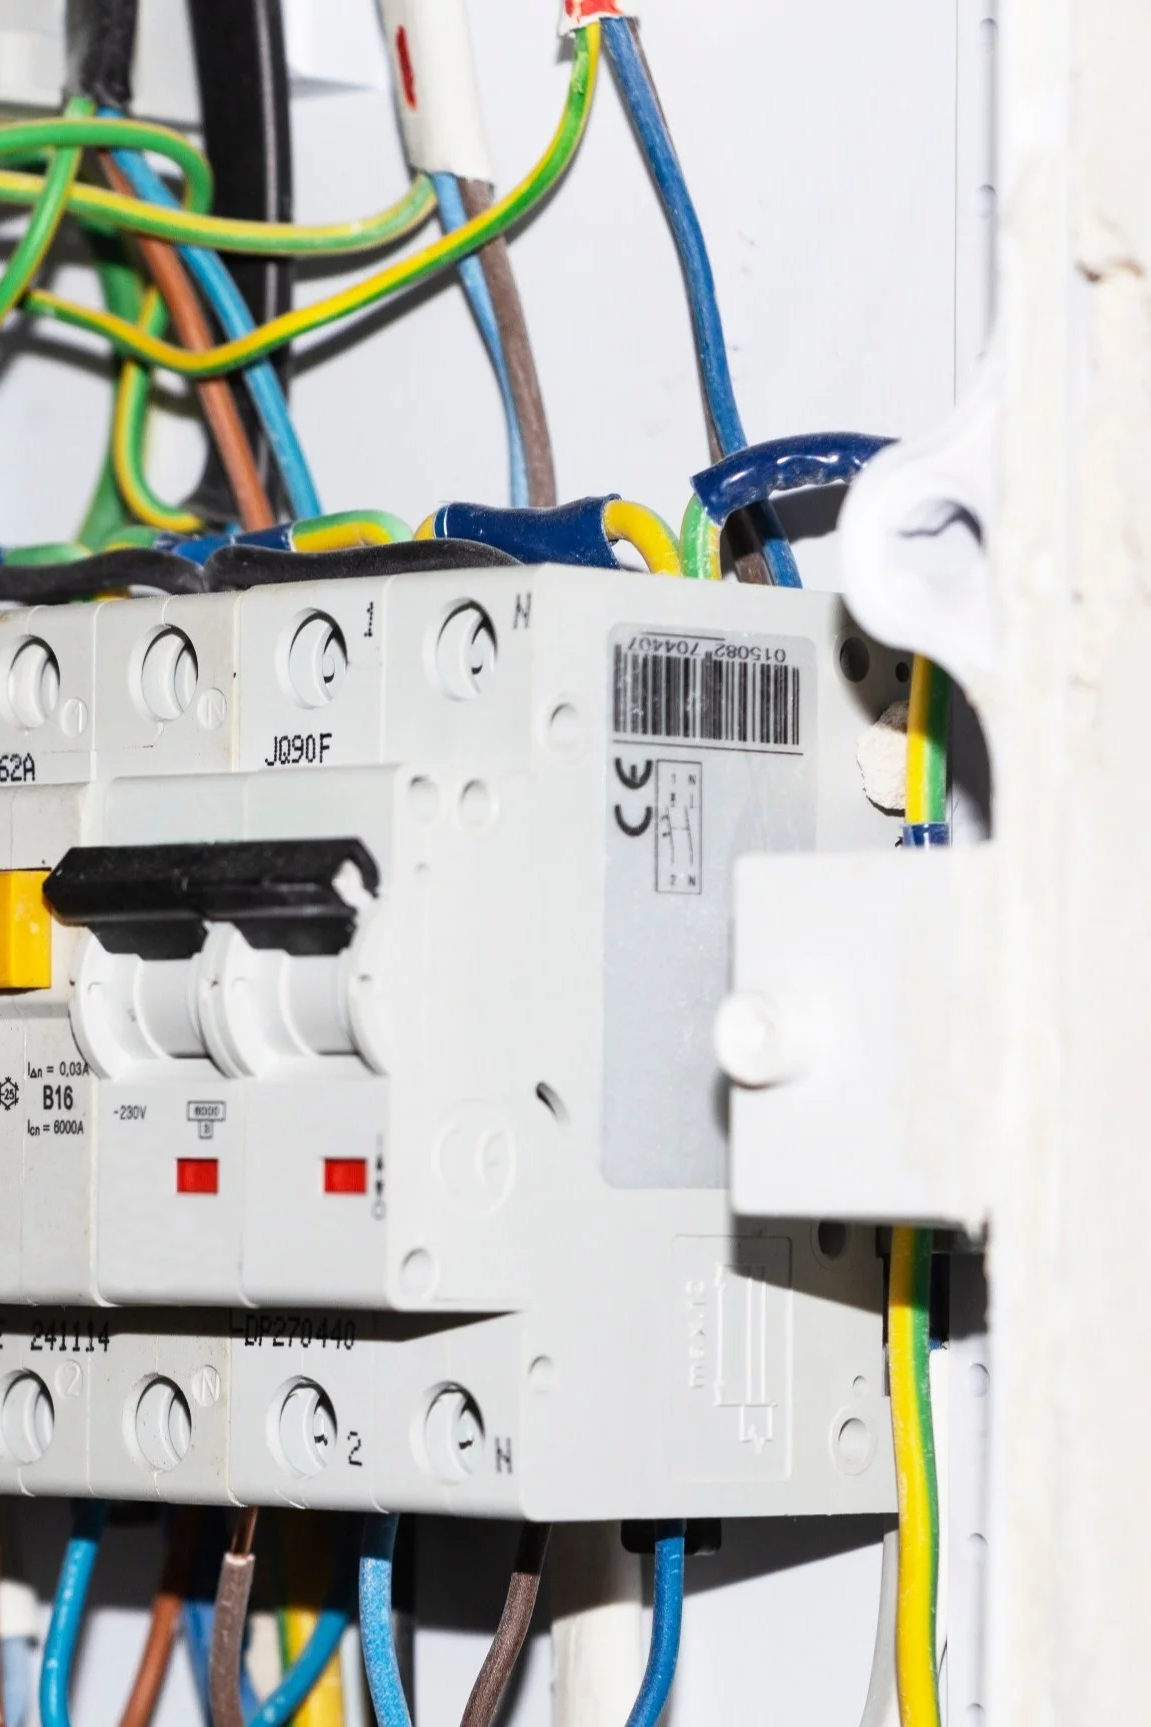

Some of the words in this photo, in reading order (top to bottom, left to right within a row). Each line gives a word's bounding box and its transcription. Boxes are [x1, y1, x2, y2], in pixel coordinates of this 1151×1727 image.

[714, 643, 787, 663] 015082
[264, 732, 334, 767] JQ90F
[42, 1084, 74, 1111] B16
[53, 1119, 85, 1136] 6000A
[29, 1320, 111, 1353] 241114
[347, 1430, 363, 1467] 2
